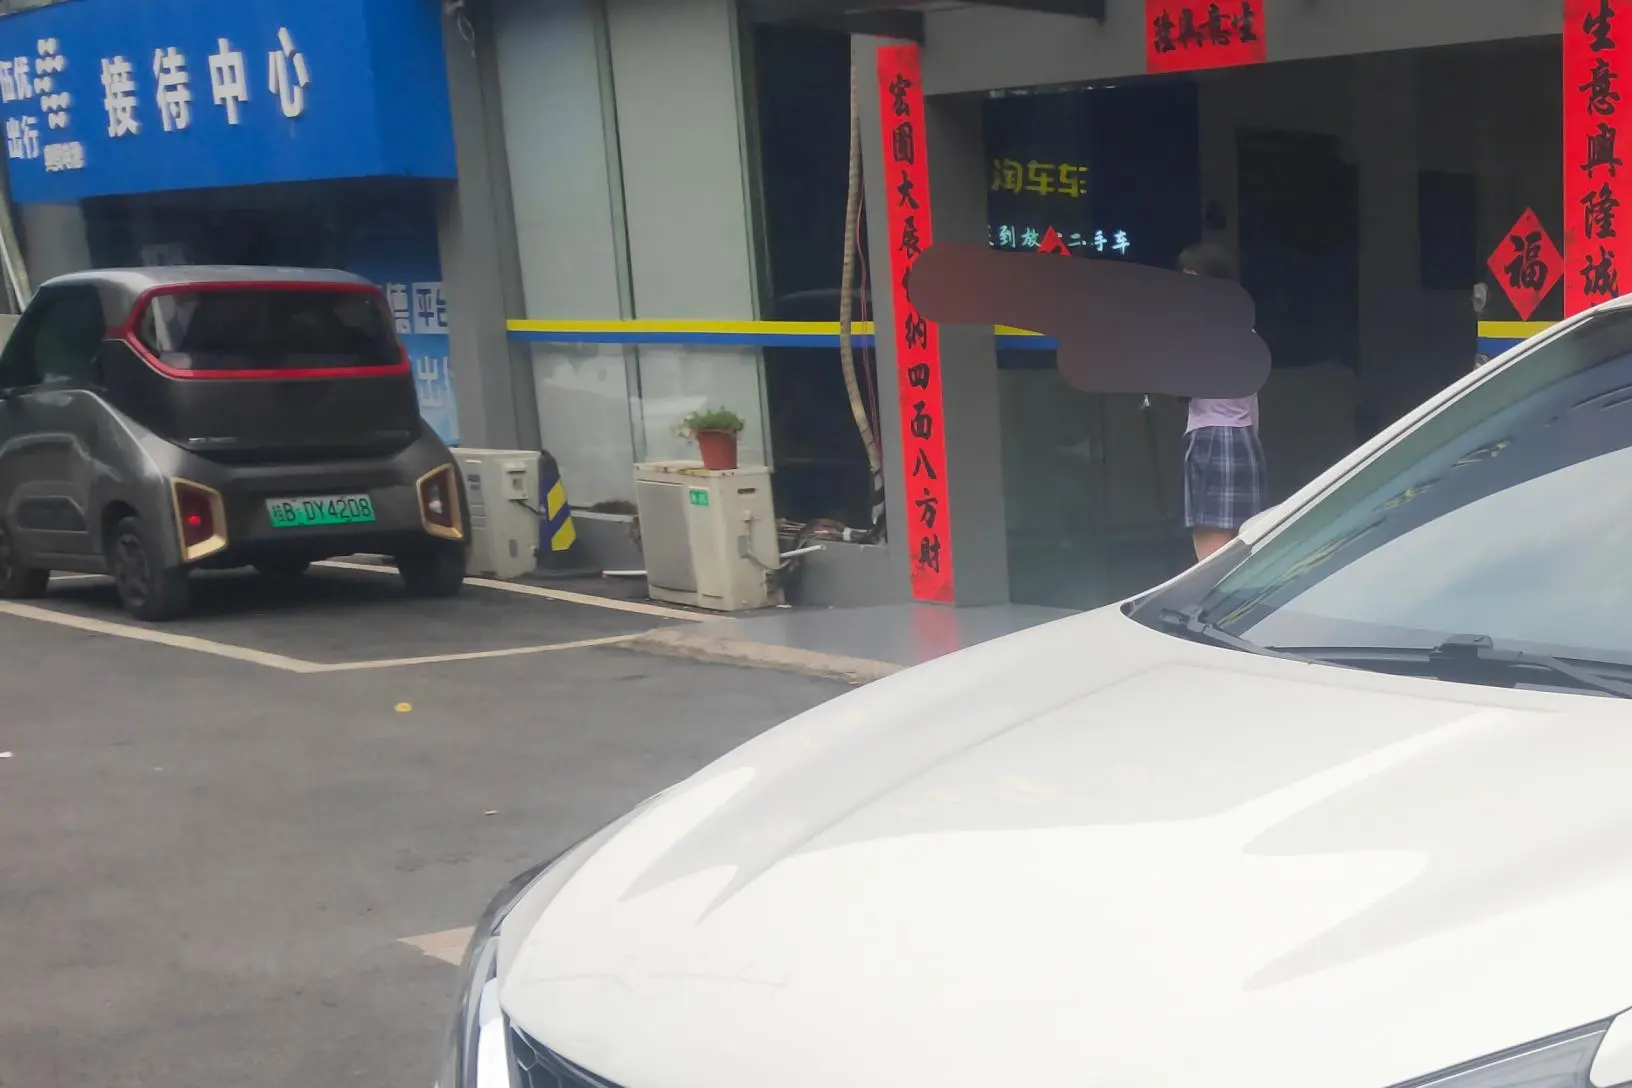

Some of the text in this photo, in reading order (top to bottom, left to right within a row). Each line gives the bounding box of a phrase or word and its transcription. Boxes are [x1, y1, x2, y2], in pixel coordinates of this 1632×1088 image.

[101, 26, 309, 137] 接待中心
[991, 158, 1088, 198] 淘车车
[1579, 3, 1623, 307] 生意興隆誠
[988, 224, 1131, 254] 到放二手车
[1504, 231, 1548, 290] 福
